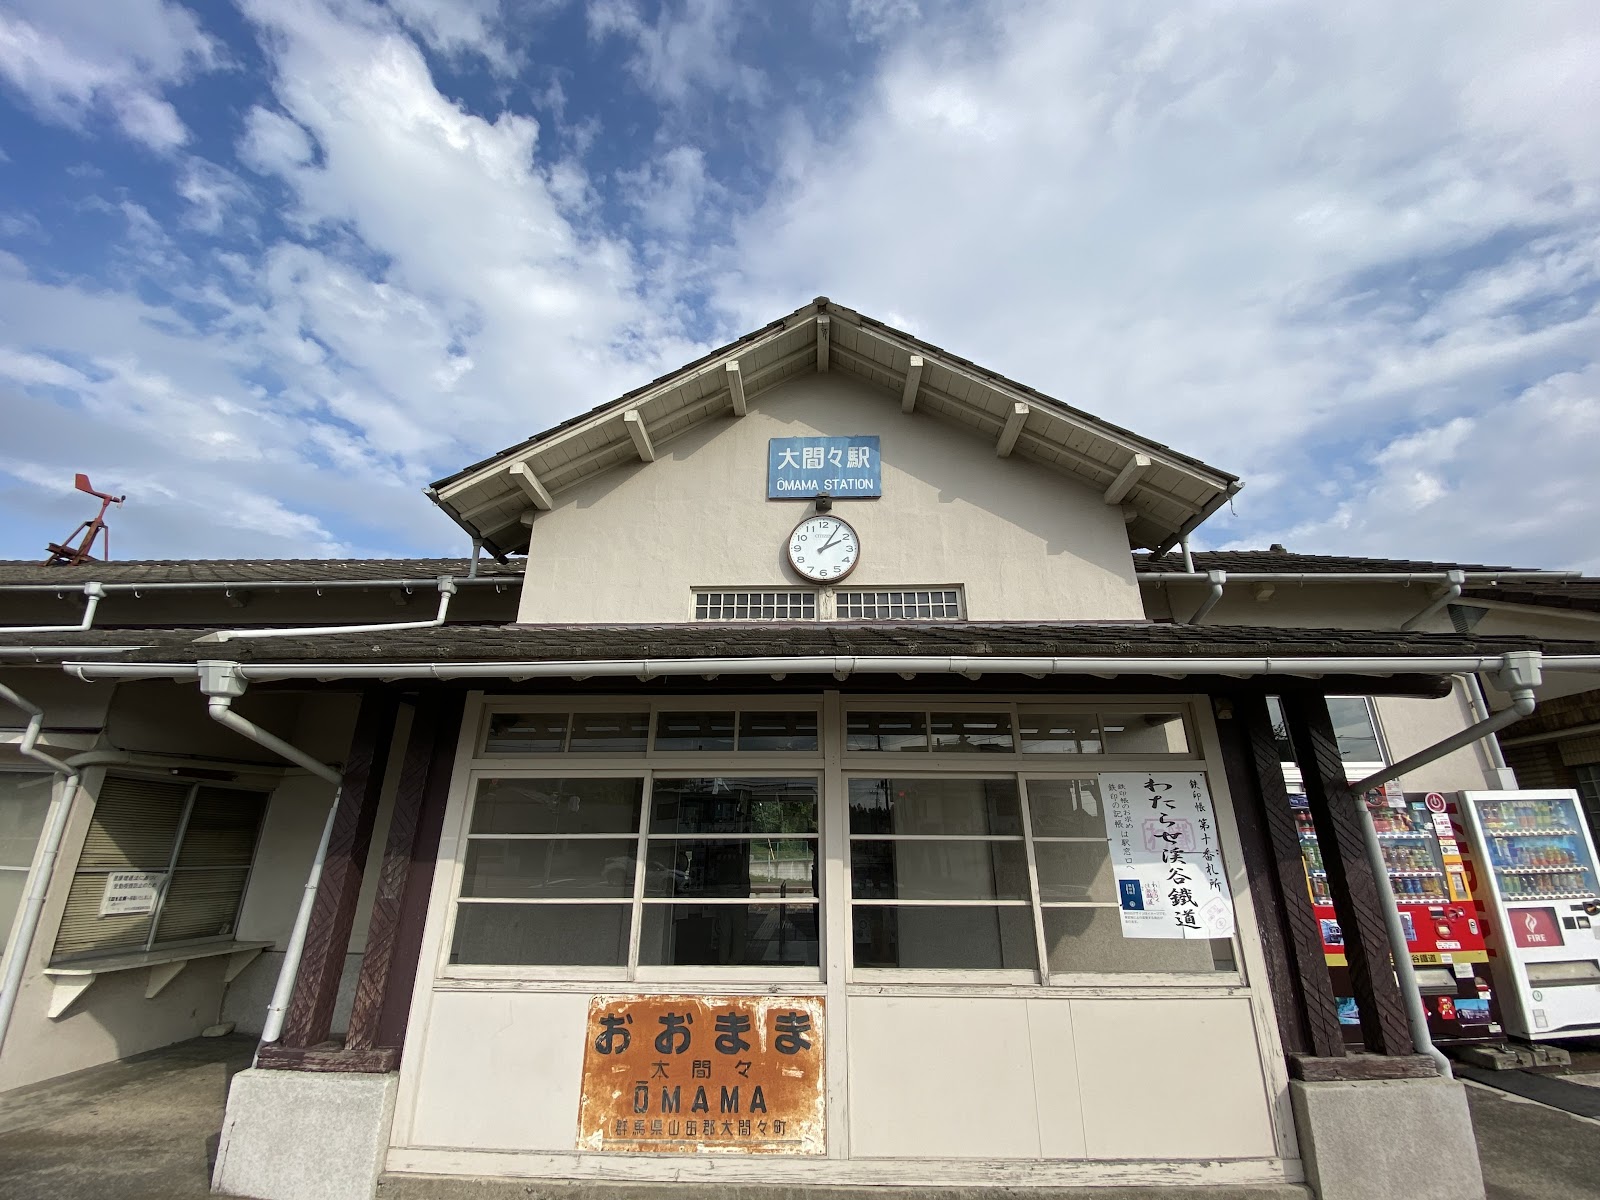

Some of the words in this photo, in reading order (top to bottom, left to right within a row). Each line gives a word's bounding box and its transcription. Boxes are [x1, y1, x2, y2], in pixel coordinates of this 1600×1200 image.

[777, 446, 870, 470] 大間々駅
[824, 478, 874, 490] STATION
[806, 525, 815, 533] 11
[819, 521, 829, 529] 12
[797, 534, 808, 542] 10
[842, 533, 850, 541] 2
[793, 544, 802, 552] 9
[845, 545, 854, 553] 3
[796, 556, 805, 564] 8
[819, 569, 828, 577] 6
[833, 565, 842, 573] 5
[1526, 933, 1547, 943] FIRE
[594, 1011, 812, 1055] おおまま
[650, 1059, 752, 1080] 大間々
[615, 1118, 787, 1137] 群馬県山田郡大間々町
